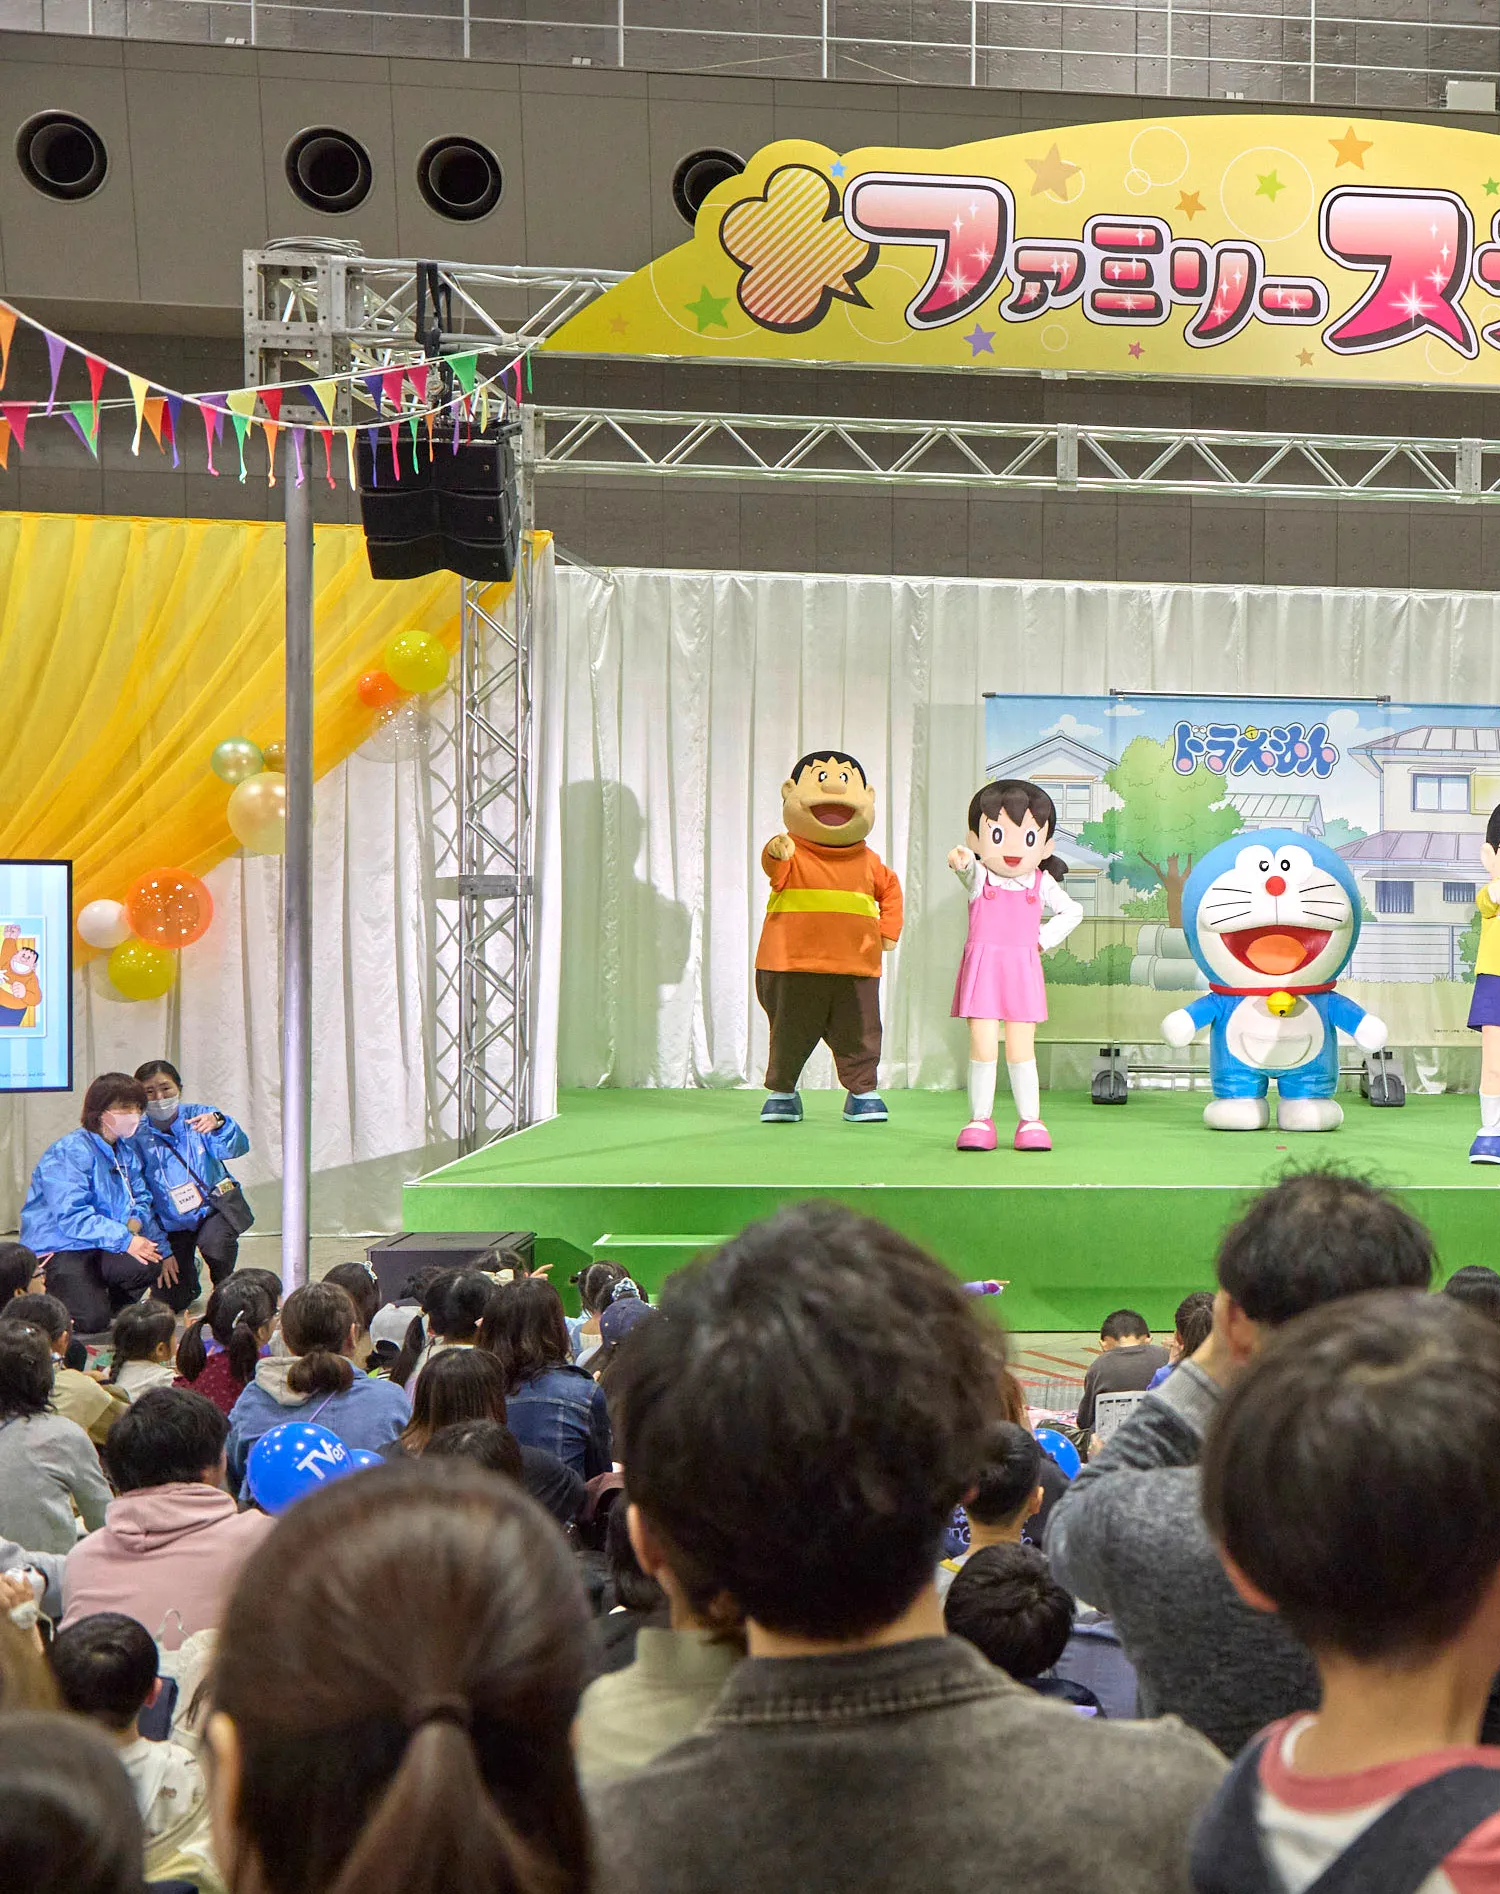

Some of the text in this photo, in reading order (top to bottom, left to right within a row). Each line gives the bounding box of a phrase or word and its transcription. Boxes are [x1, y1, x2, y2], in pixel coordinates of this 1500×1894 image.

[1173, 720, 1340, 779] ドラえもん
[296, 1438, 346, 1480] TVer
